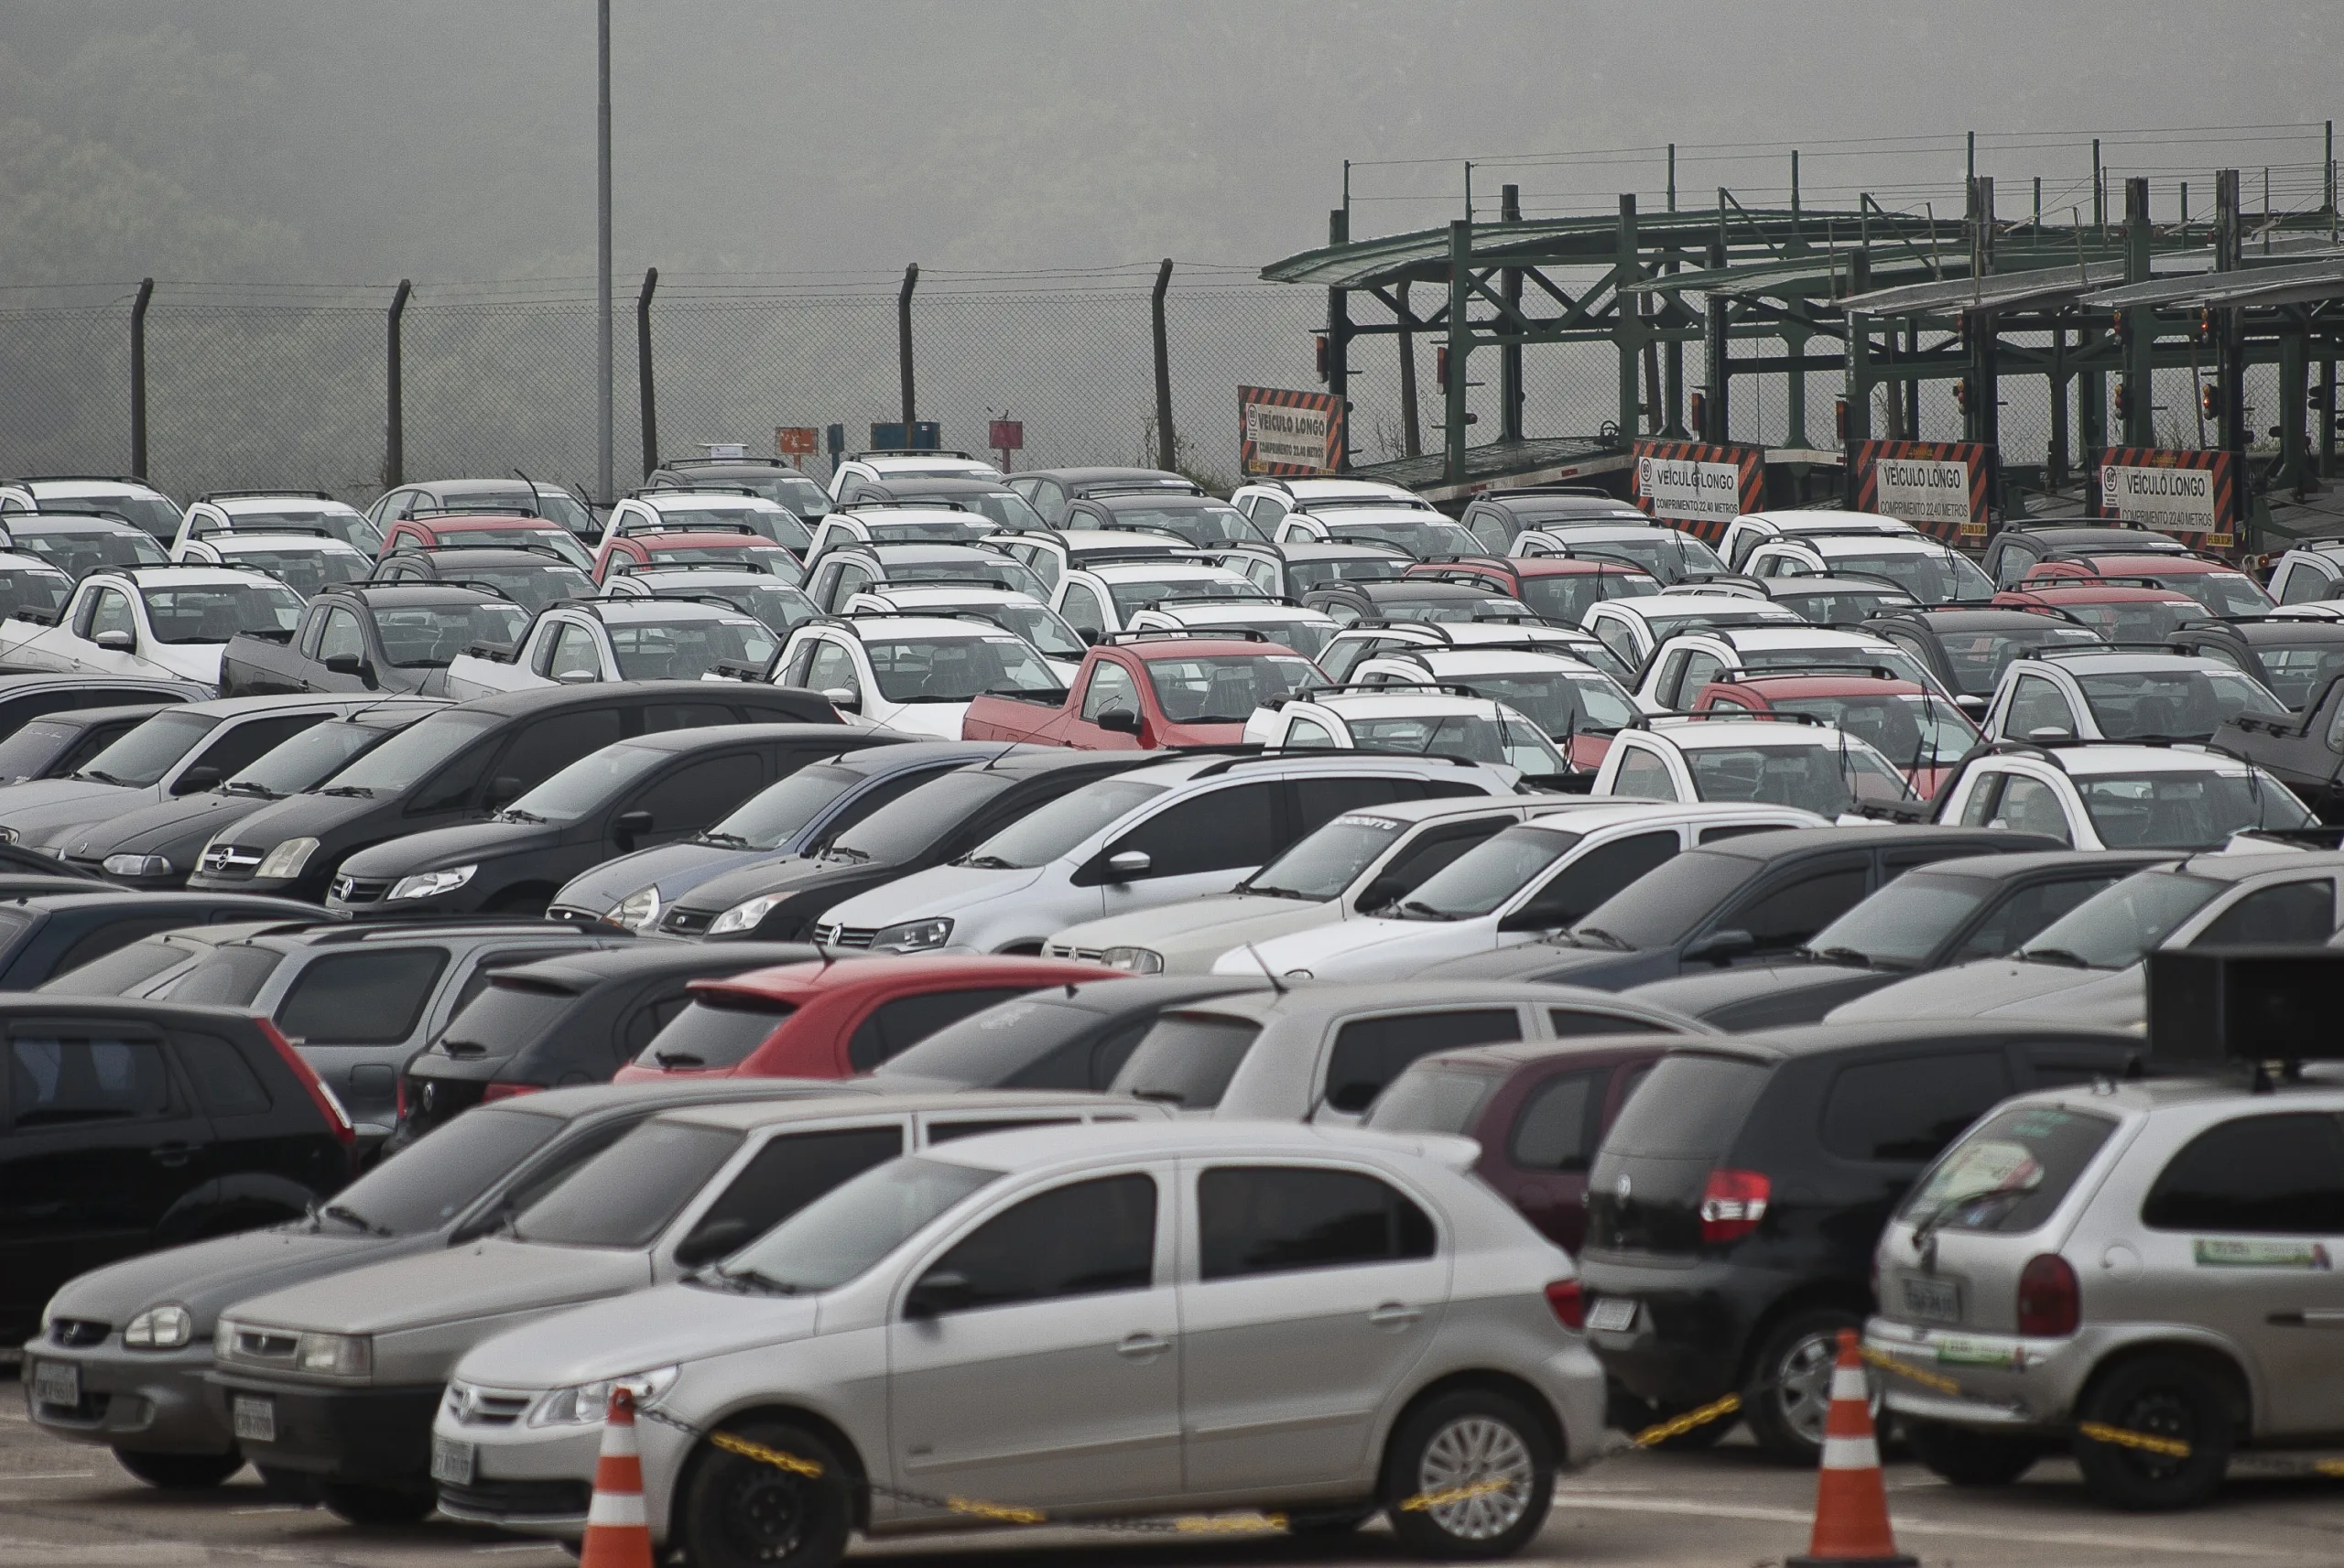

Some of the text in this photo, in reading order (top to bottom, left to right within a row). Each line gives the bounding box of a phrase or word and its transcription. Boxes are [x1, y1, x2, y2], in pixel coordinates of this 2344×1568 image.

[1257, 410, 1325, 437] VEÍCULO LONGO
[1701, 472, 1734, 490] LONGO
[1883, 462, 1961, 489] VEÍCULO LONGO
[2126, 470, 2205, 497] VEÍCULO LONGO
[1656, 498, 1698, 512] COMPRIMENTO
[1714, 503, 1738, 514] METROS
[1880, 501, 1925, 516] COMPRIMENTO
[1942, 503, 1968, 517] METROS
[2122, 509, 2167, 524] COMPRIMENTO
[2186, 512, 2212, 526] METROS
